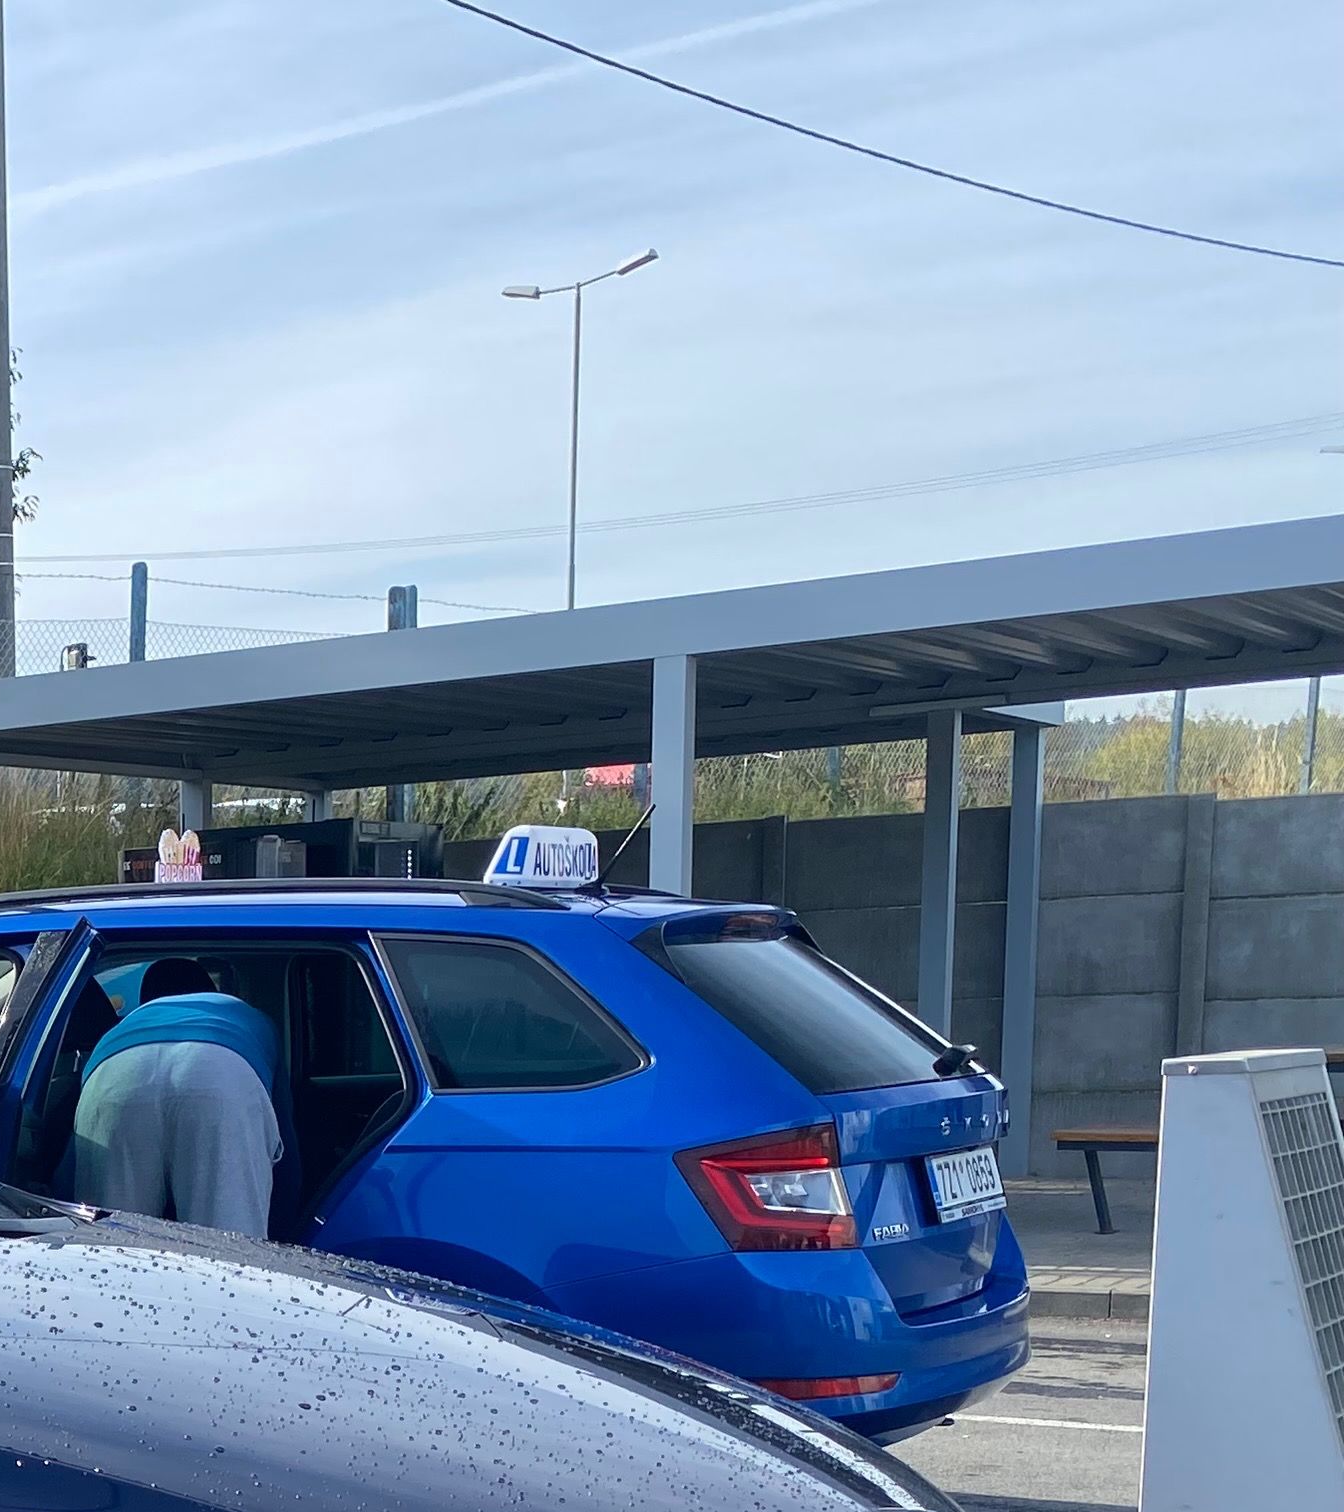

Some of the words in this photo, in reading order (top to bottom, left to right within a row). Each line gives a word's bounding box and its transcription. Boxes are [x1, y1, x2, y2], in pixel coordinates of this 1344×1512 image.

[159, 863, 202, 882] POPCORN
[965, 1154, 996, 1194] 0859
[873, 1224, 909, 1240] FABIA
